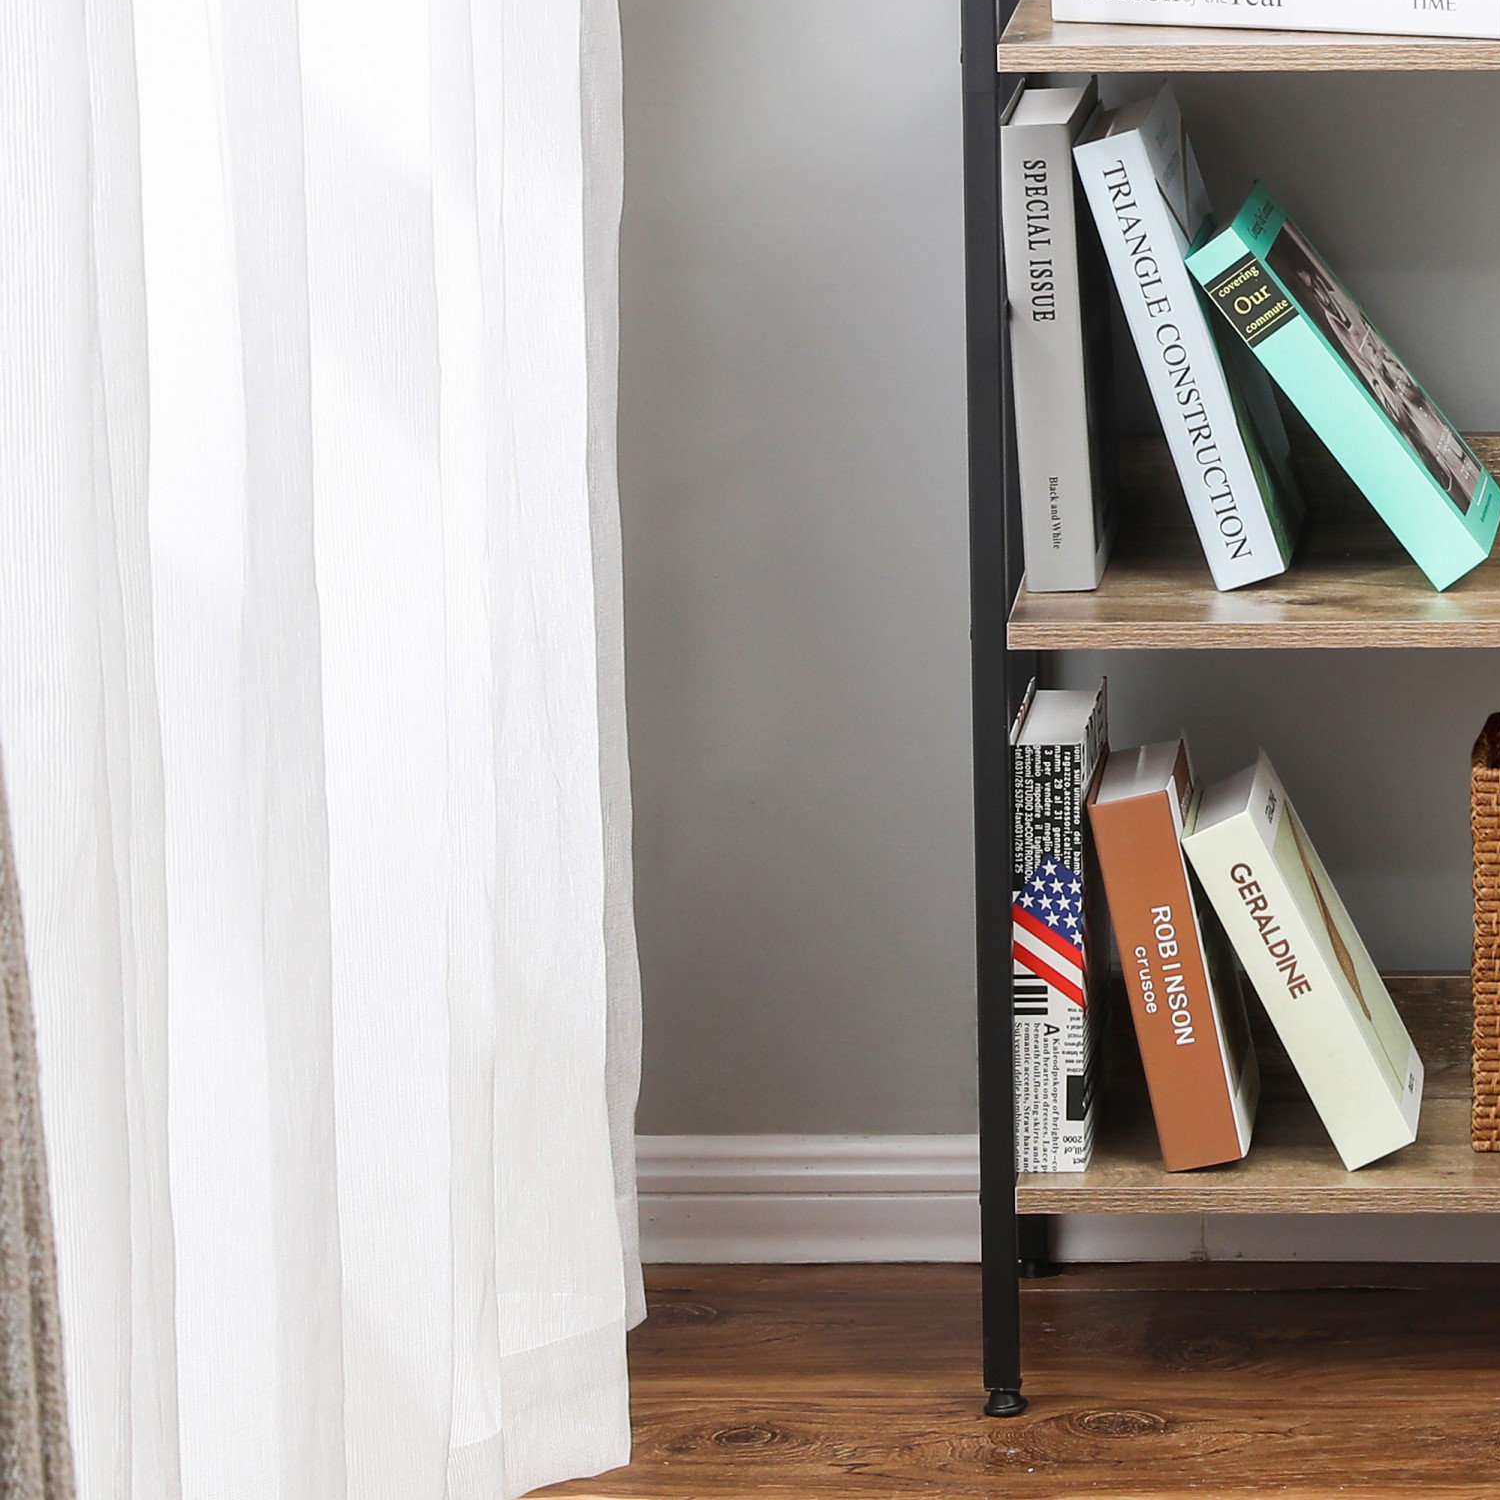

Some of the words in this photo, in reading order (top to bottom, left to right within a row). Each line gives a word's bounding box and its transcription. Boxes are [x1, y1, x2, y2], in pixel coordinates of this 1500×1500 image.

[1023, 159, 1052, 250] SPECIAL
[1030, 260, 1055, 322] ISSUE
[1218, 266, 1260, 297] covering
[1233, 285, 1271, 314] Our
[1245, 299, 1289, 333] commute
[1103, 160, 1172, 318] TRIANGLE
[1155, 324, 1253, 560] CONSTRUCTION
[1049, 476, 1059, 502] Black
[1050, 504, 1060, 520] and
[1052, 522, 1061, 550] White
[1033, 745, 1043, 777] gennaio
[1043, 761, 1051, 777] per
[1025, 779, 1033, 811] STUDIO
[1054, 778, 1063, 789] 29
[1033, 783, 1043, 818] rispedire
[1044, 782, 1053, 816] vendere
[1054, 795, 1063, 804] al
[1054, 810, 1063, 820] 31
[1043, 823, 1053, 852] meglio
[1230, 863, 1312, 1000] GERALDINE
[1134, 946, 1158, 1014] crusoe
[1151, 905, 1196, 1045] ROBINSON
[1033, 1023, 1041, 1059] beneath
[1043, 1088, 1049, 1100] on
[1023, 1106, 1031, 1133] Straw
[1052, 1106, 1059, 1115] of
[1023, 1135, 1031, 1155] hats
[1062, 1135, 1082, 1143] 2000
